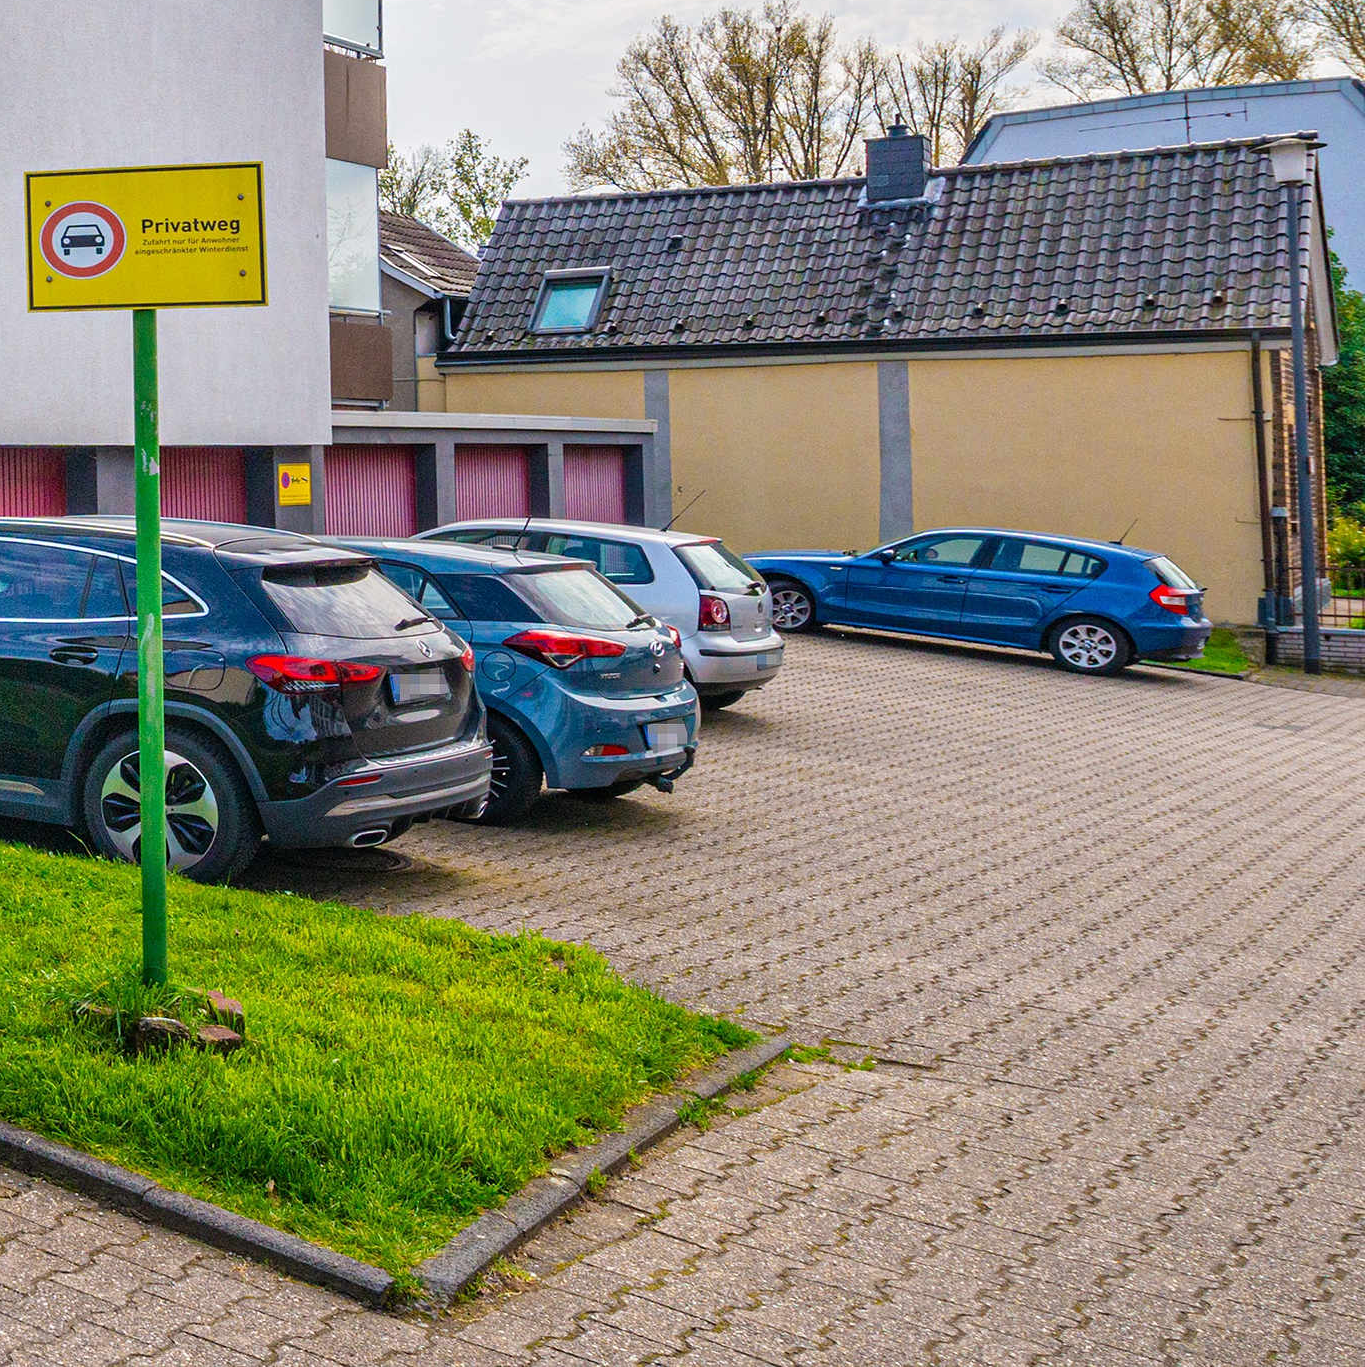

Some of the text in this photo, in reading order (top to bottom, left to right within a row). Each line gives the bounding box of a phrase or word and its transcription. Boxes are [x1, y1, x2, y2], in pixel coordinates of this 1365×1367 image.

[142, 218, 240, 234] Privatweg
[201, 236, 240, 244] Anwohner
[135, 245, 249, 256] eingeschränkter Winterdienst
